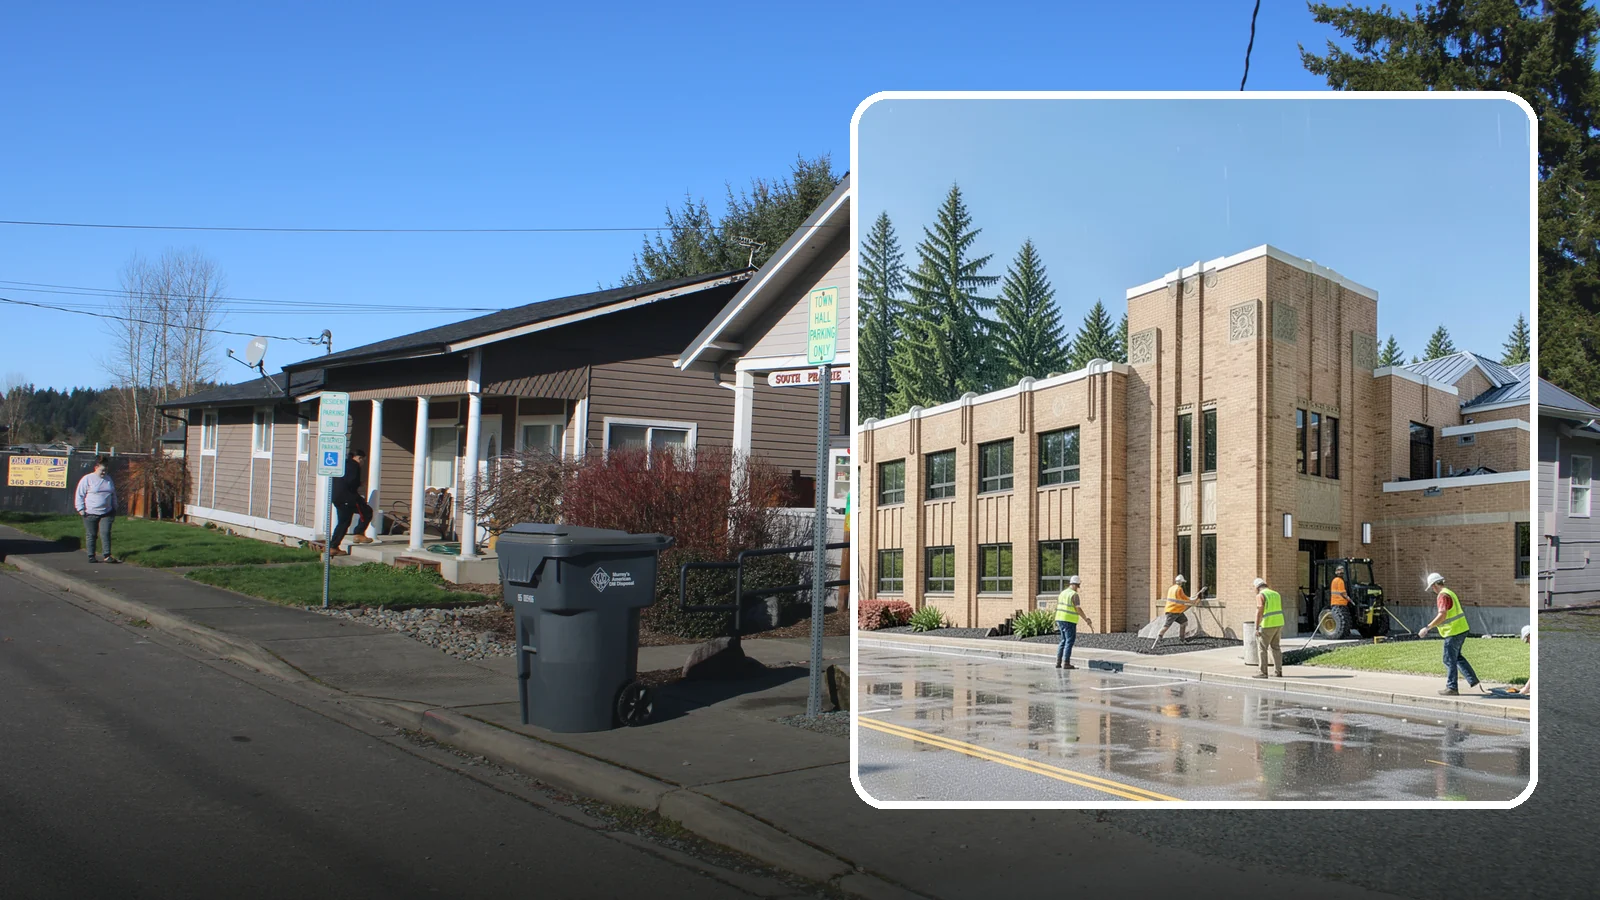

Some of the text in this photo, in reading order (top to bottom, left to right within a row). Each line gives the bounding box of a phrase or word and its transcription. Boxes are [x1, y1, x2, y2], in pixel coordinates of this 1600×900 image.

[815, 295, 833, 308] TOWN
[814, 311, 831, 324] HALL
[810, 326, 836, 340] PARKING
[813, 344, 831, 357] ONLY
[775, 373, 801, 384] SOUTH
